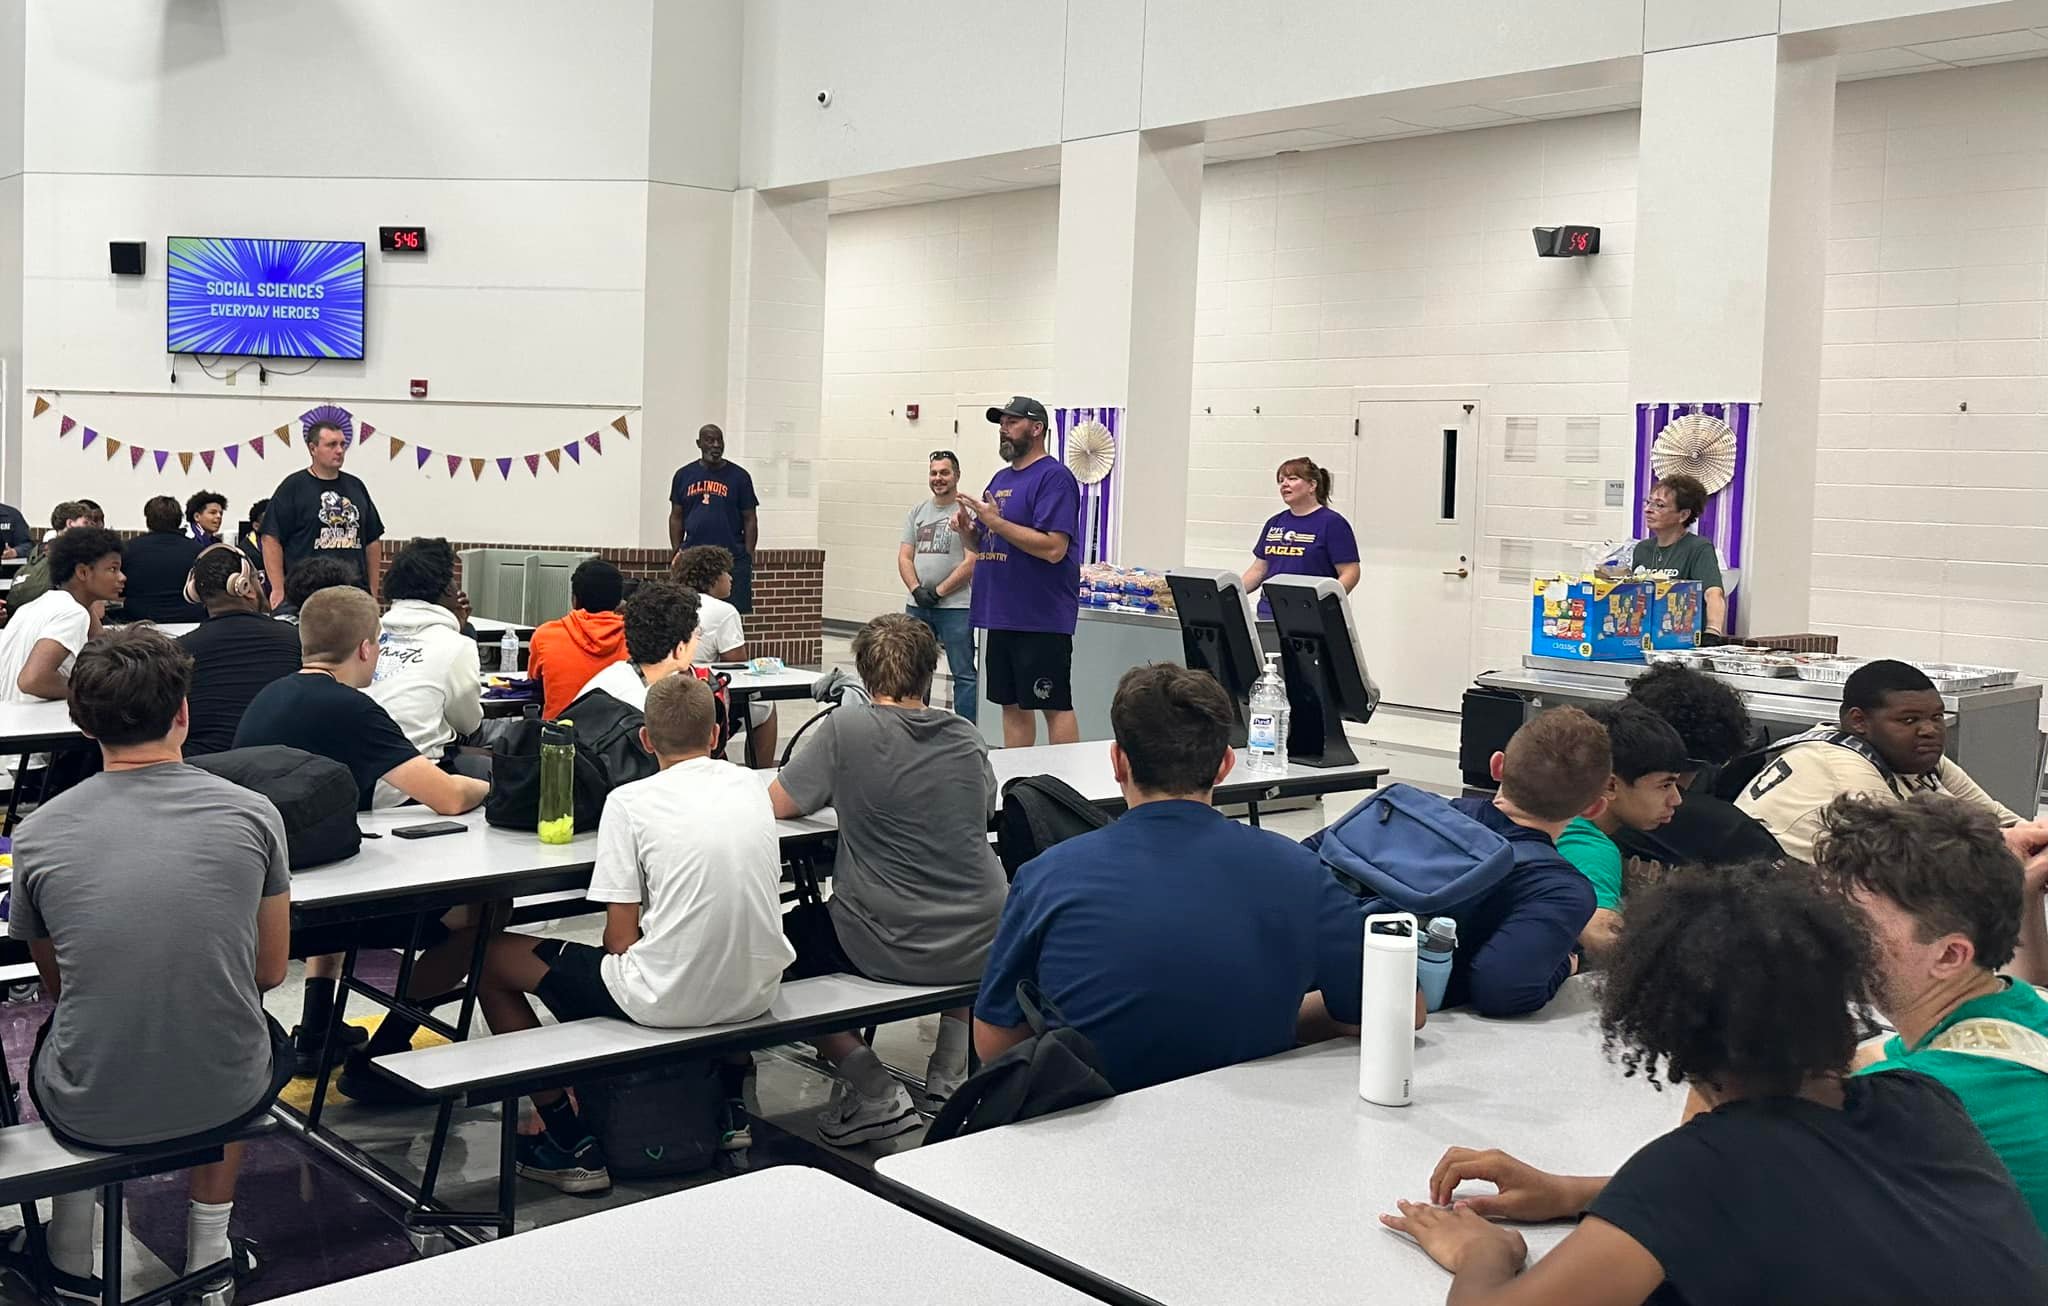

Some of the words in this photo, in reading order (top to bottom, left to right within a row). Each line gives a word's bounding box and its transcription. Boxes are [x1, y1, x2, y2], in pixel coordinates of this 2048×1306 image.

[394, 231, 418, 248] 5:46
[206, 281, 254, 297] SOCIAL
[257, 283, 325, 299] SCIENCES
[210, 303, 270, 318] EVERYDAY
[272, 305, 320, 320] HEROES
[687, 480, 728, 496] ILLINOIS
[1264, 545, 1306, 557] EAGLES
